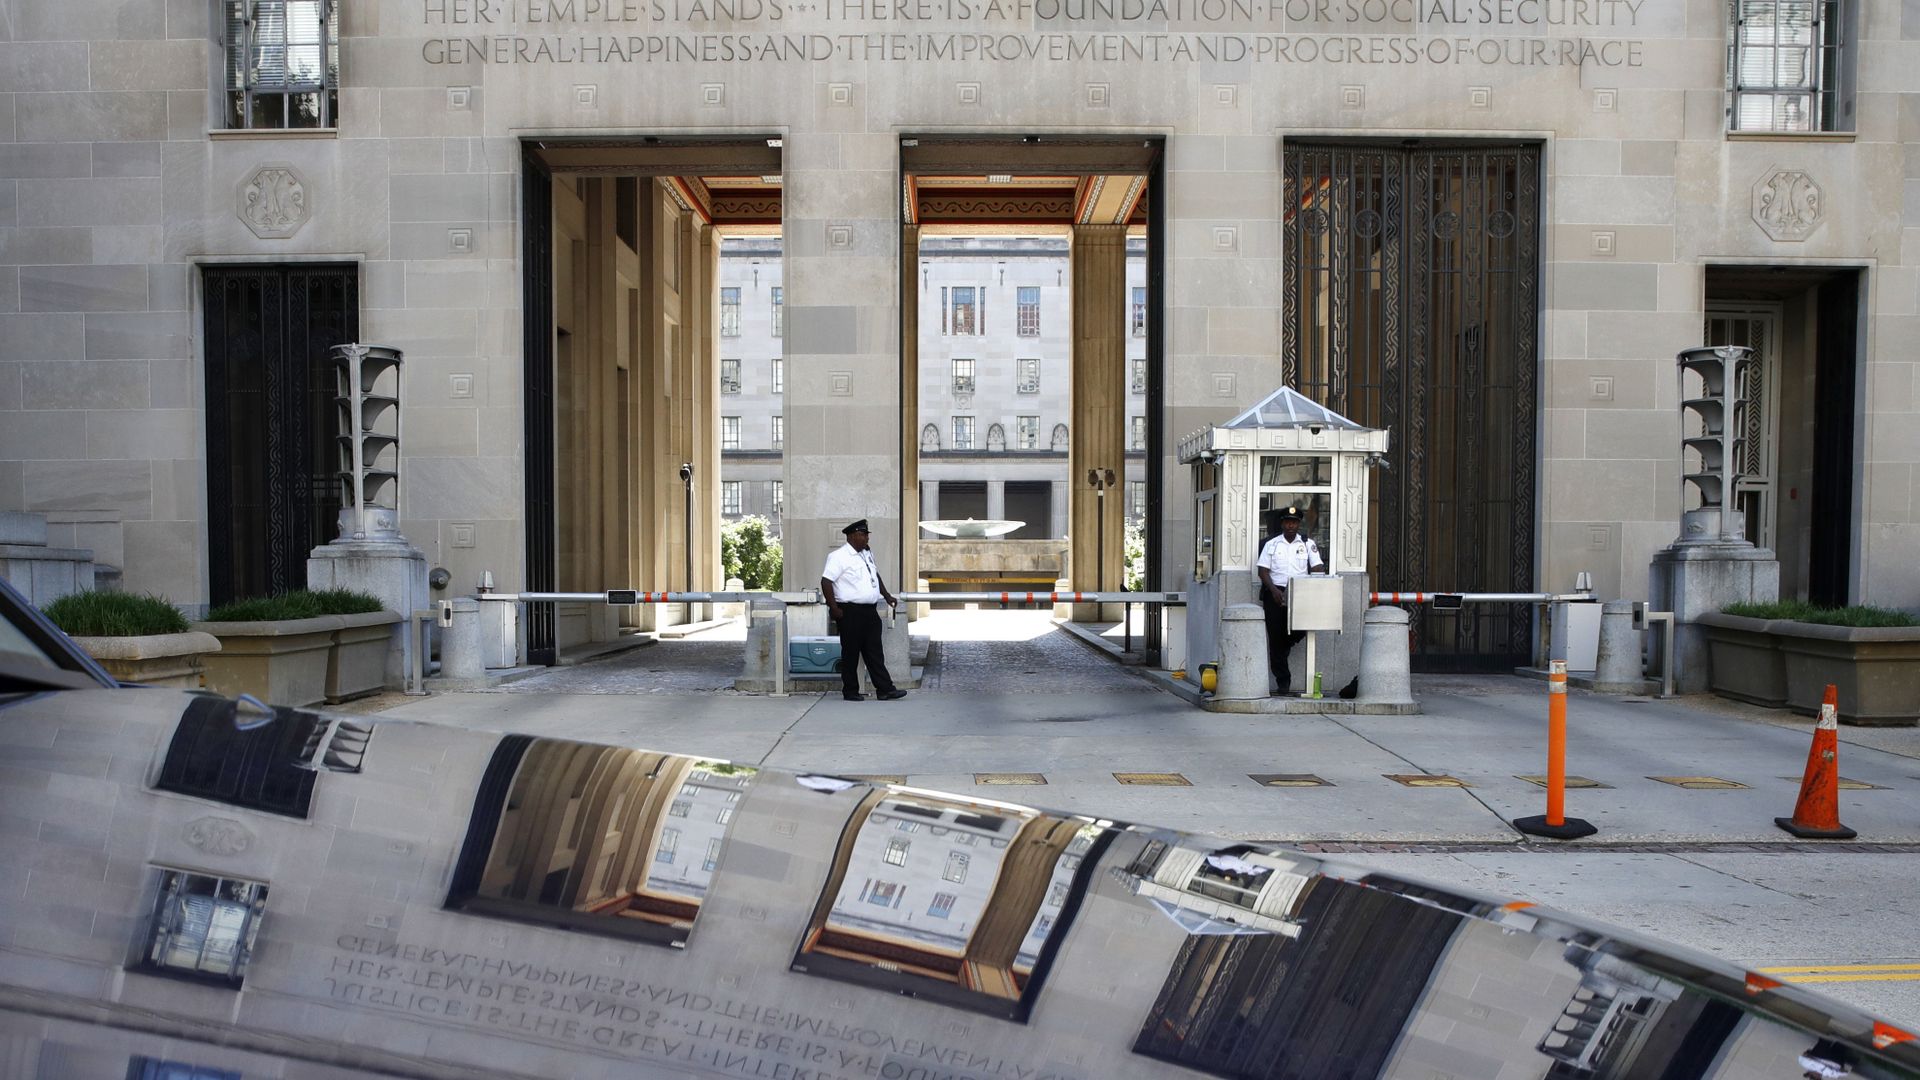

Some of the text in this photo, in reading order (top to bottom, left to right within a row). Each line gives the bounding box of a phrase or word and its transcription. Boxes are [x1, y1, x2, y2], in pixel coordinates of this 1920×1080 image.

[1344, 0, 1468, 24] SOCIAL
[1478, 0, 1645, 26] SECURITY
[421, 33, 1644, 68] GENERAL HAPPINESS AND THE IMPROVEMENT AND PROGRESS OF OUR RACE
